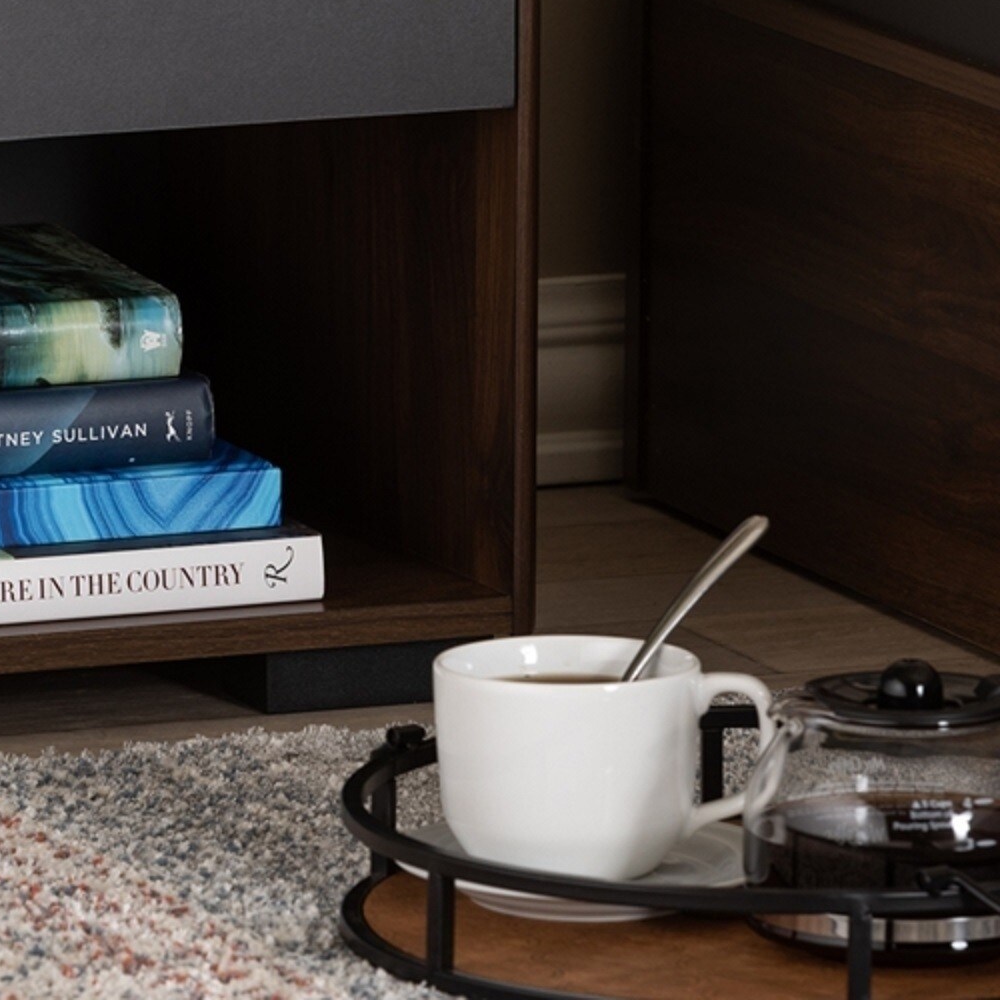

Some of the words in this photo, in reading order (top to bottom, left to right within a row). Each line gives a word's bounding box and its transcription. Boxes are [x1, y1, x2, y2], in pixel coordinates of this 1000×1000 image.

[52, 422, 148, 444] SULLIVAN
[39, 576, 66, 600] IN
[70, 571, 122, 598] THE
[127, 562, 245, 593] COUNTRY
